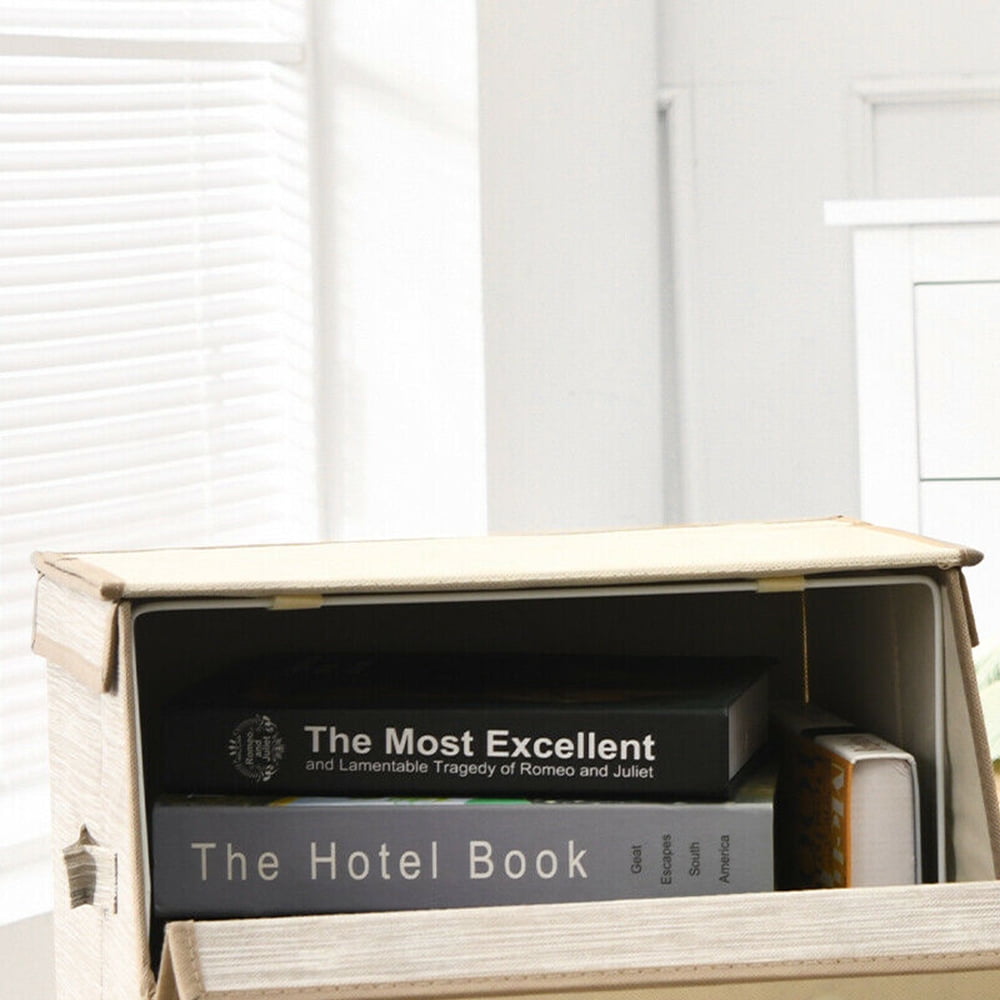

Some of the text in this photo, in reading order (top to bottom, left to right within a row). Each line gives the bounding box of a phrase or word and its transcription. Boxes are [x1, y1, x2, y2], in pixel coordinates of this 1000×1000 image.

[304, 726, 656, 761] The Most Excellent
[306, 757, 655, 780] and Lamentable Tragedy of Romeo and Juliet
[191, 839, 589, 882] The Hotel Book
[660, 834, 674, 885] Escapes
[688, 841, 701, 877] South
[718, 834, 731, 885] America
